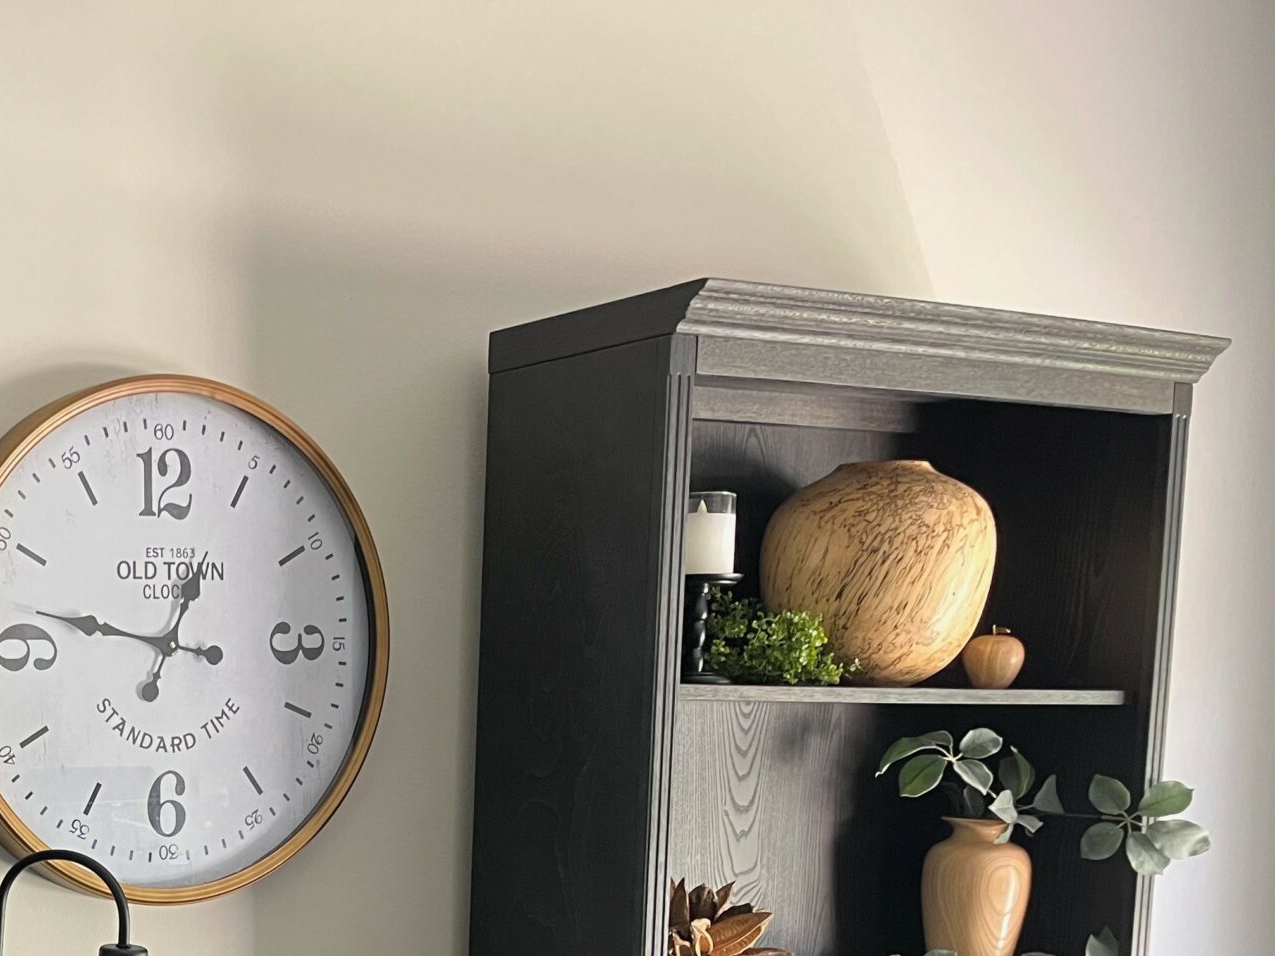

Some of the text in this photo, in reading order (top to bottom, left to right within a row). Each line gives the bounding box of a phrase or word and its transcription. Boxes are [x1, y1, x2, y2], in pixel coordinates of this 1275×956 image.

[153, 423, 175, 441] 60
[61, 445, 80, 470] 55
[248, 454, 261, 470] 5
[135, 446, 193, 521] 12
[307, 532, 323, 551] 10
[145, 547, 196, 559] EST 1863
[116, 560, 224, 581] OLD TOWN
[142, 583, 184, 600] CLOC
[270, 621, 325, 666] 3
[332, 636, 346, 652] 15
[96, 697, 241, 753] STANDARD TIME
[306, 732, 324, 755] 20
[147, 769, 187, 838] 6
[69, 818, 90, 841] 35
[158, 843, 179, 861] 30
